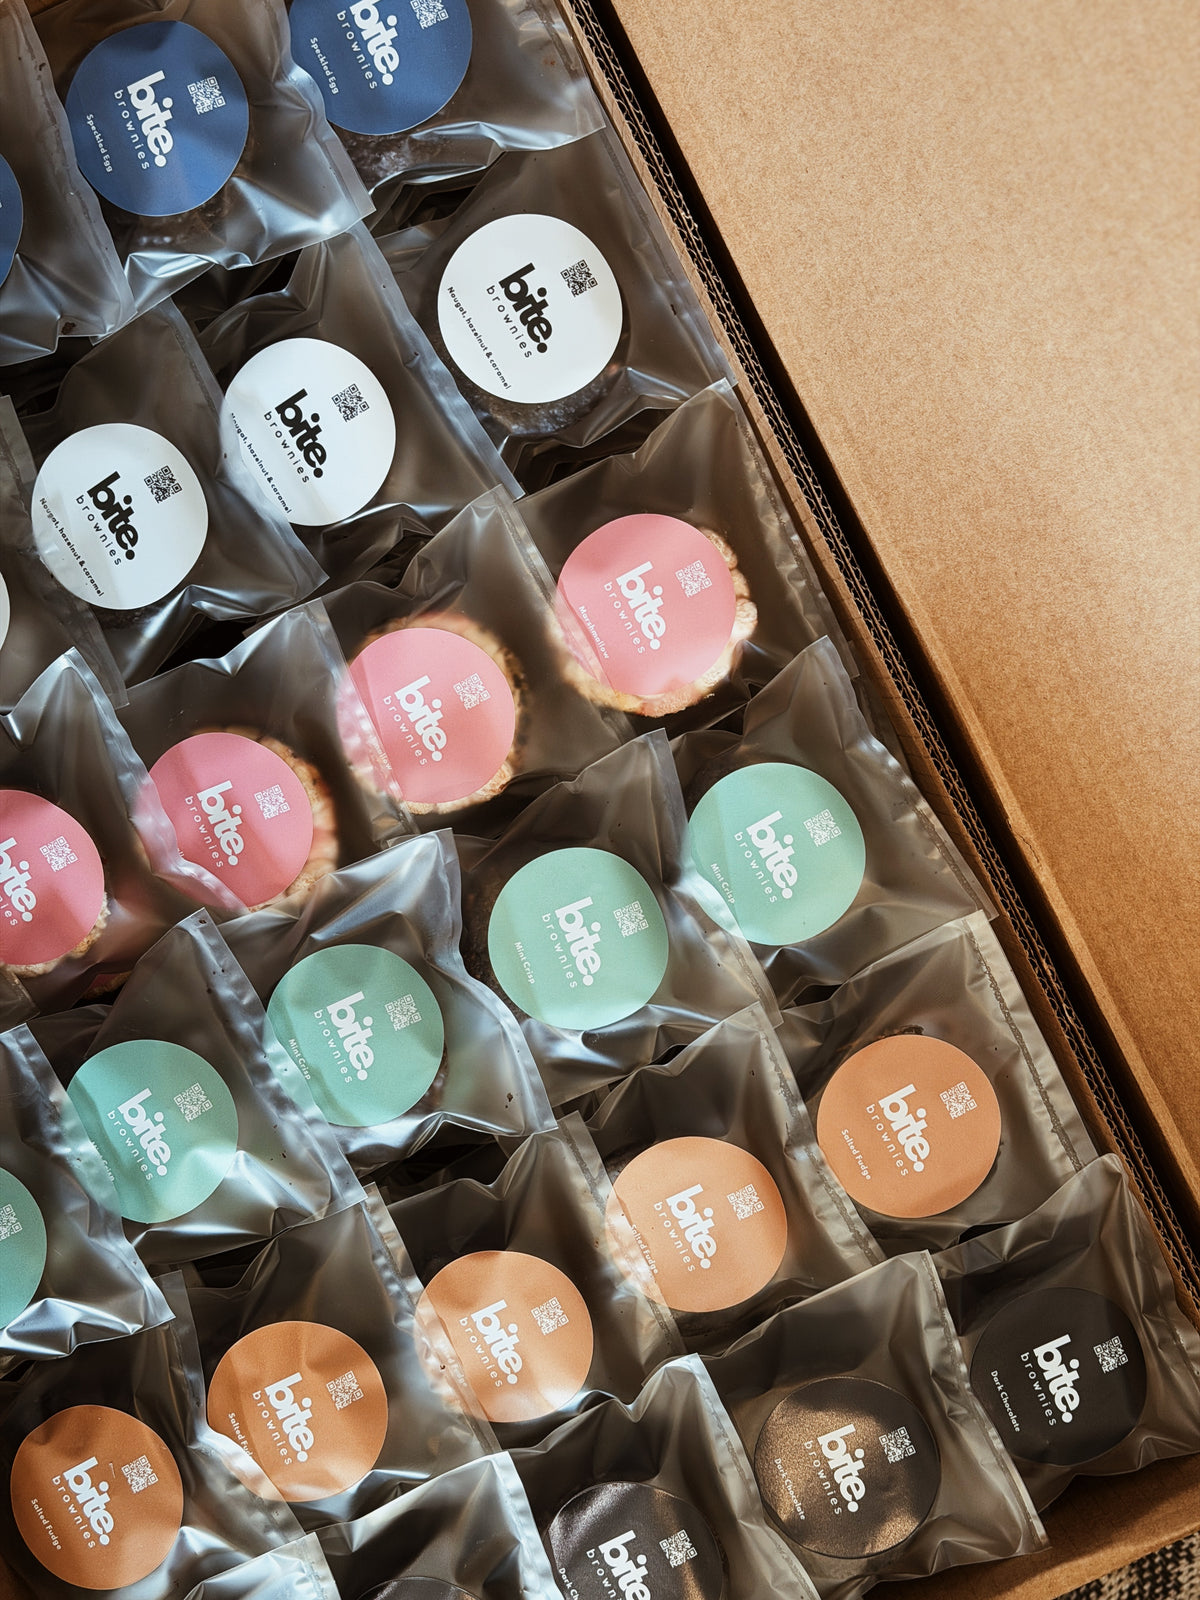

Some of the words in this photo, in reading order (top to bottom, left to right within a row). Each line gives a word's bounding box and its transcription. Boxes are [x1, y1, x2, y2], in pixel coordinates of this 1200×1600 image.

[310, 38, 333, 77] Speckled
[329, 78, 339, 95] Egg
[337, 10, 377, 89] brownies
[350, 0, 399, 85] bite.
[87, 114, 107, 154] Speckled
[103, 155, 112, 172] Egg
[114, 89, 149, 169] brownies
[127, 70, 173, 167] bite.
[448, 287, 467, 318] Nougat,
[466, 318, 488, 352] hazelnut
[490, 359, 511, 389] caramel
[486, 285, 532, 358] brownies
[499, 262, 552, 353] bite.
[231, 413, 247, 444] ugat,
[247, 444, 269, 477] hazelnut
[271, 484, 292, 513] caramel
[264, 411, 309, 482] brownies
[275, 388, 327, 478] bite.
[76, 495, 121, 565] brownies
[87, 471, 138, 560] bite.
[59, 528, 81, 560] hazelnut
[83, 567, 104, 597] caramel
[579, 606, 609, 659] Marshmallow
[604, 581, 645, 653] brownies
[616, 561, 666, 650] bite.
[383, 696, 427, 765] brownies
[394, 675, 447, 761] bite.
[185, 796, 223, 867] brownies
[197, 780, 244, 865] bite.
[746, 810, 798, 899] bite.
[710, 863, 724, 883] Mint
[721, 882, 735, 904] Crisp
[734, 832, 777, 903] brownies
[514, 942, 526, 962] Mint
[523, 961, 535, 984] Crisp
[542, 913, 577, 988] brownies
[555, 896, 601, 986] bite.
[289, 1039, 301, 1057] Mint
[298, 1058, 311, 1080] Crisp
[314, 1009, 352, 1083] brownies
[326, 991, 374, 1080] bite.
[108, 1110, 153, 1180] brownies
[117, 1088, 171, 1176] bite.
[841, 1129, 859, 1158] Salted
[855, 1155, 871, 1180] Fudge
[866, 1104, 908, 1176] brownies
[878, 1084, 930, 1172] bite.
[643, 1250, 658, 1274] Fudge
[654, 1202, 695, 1272] brownies
[666, 1184, 717, 1269] bite.
[459, 1317, 502, 1387] brownies
[471, 1299, 522, 1384] bite.
[1033, 1334, 1080, 1423] bite.
[264, 1372, 314, 1462] bite.
[991, 1370, 1003, 1392] Dark
[1000, 1391, 1020, 1432] Chocolate
[1021, 1352, 1056, 1426] brownies
[228, 1412, 245, 1441] Salted
[252, 1390, 292, 1465] brownies
[63, 1456, 114, 1545] bite.
[774, 1458, 787, 1479] Dark
[785, 1479, 805, 1520] Chocolate
[804, 1440, 842, 1515] brownies
[817, 1424, 866, 1512] bite.
[31, 1498, 49, 1526] Salted
[45, 1525, 62, 1550] Fudge
[52, 1475, 96, 1548] brownies
[558, 1568, 572, 1589] Dark
[586, 1548, 619, 1600] brown
